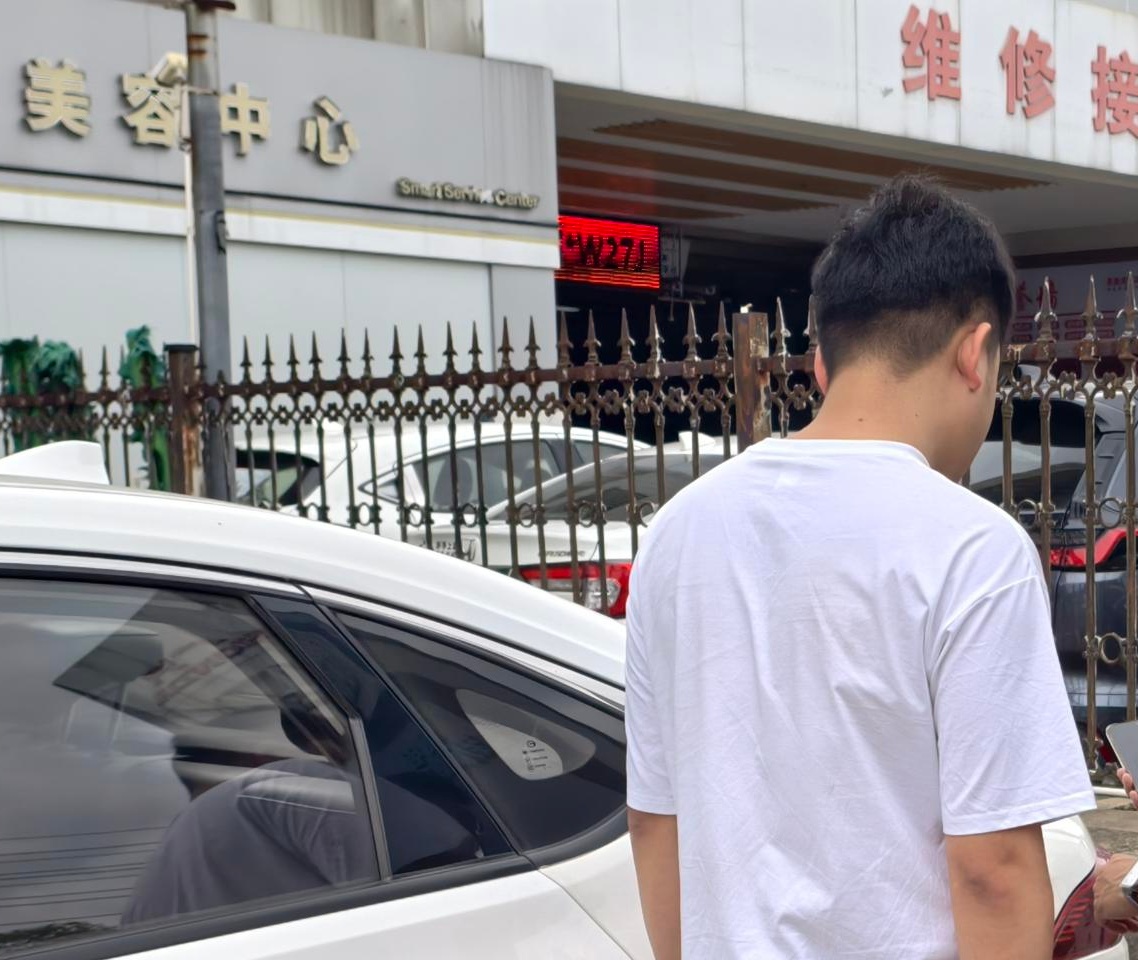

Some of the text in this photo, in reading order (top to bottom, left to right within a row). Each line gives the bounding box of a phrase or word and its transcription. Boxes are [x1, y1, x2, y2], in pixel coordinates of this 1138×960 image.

[24, 57, 359, 166] 美容中心
[397, 178, 540, 208] Smart Servi Center
